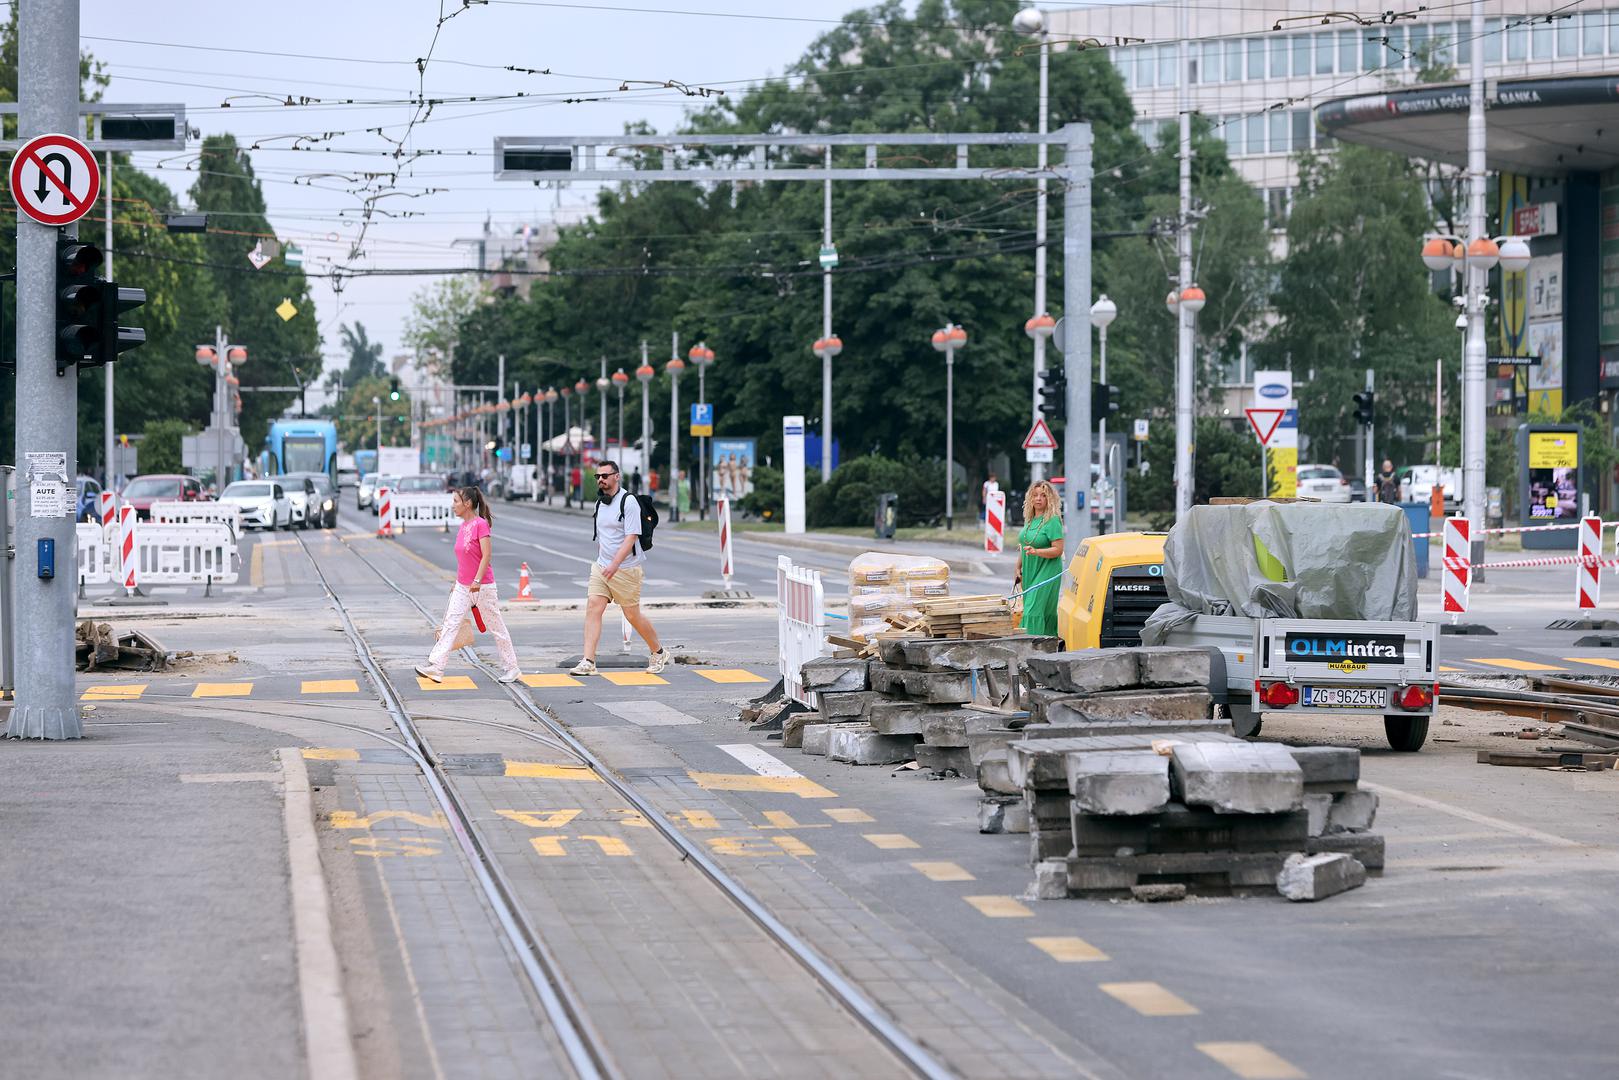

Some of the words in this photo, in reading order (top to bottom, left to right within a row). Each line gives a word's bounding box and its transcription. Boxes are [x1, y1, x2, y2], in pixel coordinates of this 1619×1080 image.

[1500, 91, 1542, 104] BANKA
[696, 404, 707, 420] P
[1291, 639, 1398, 658] OLMinfra
[1312, 689, 1328, 703] ZG
[348, 834, 818, 857] BUS
